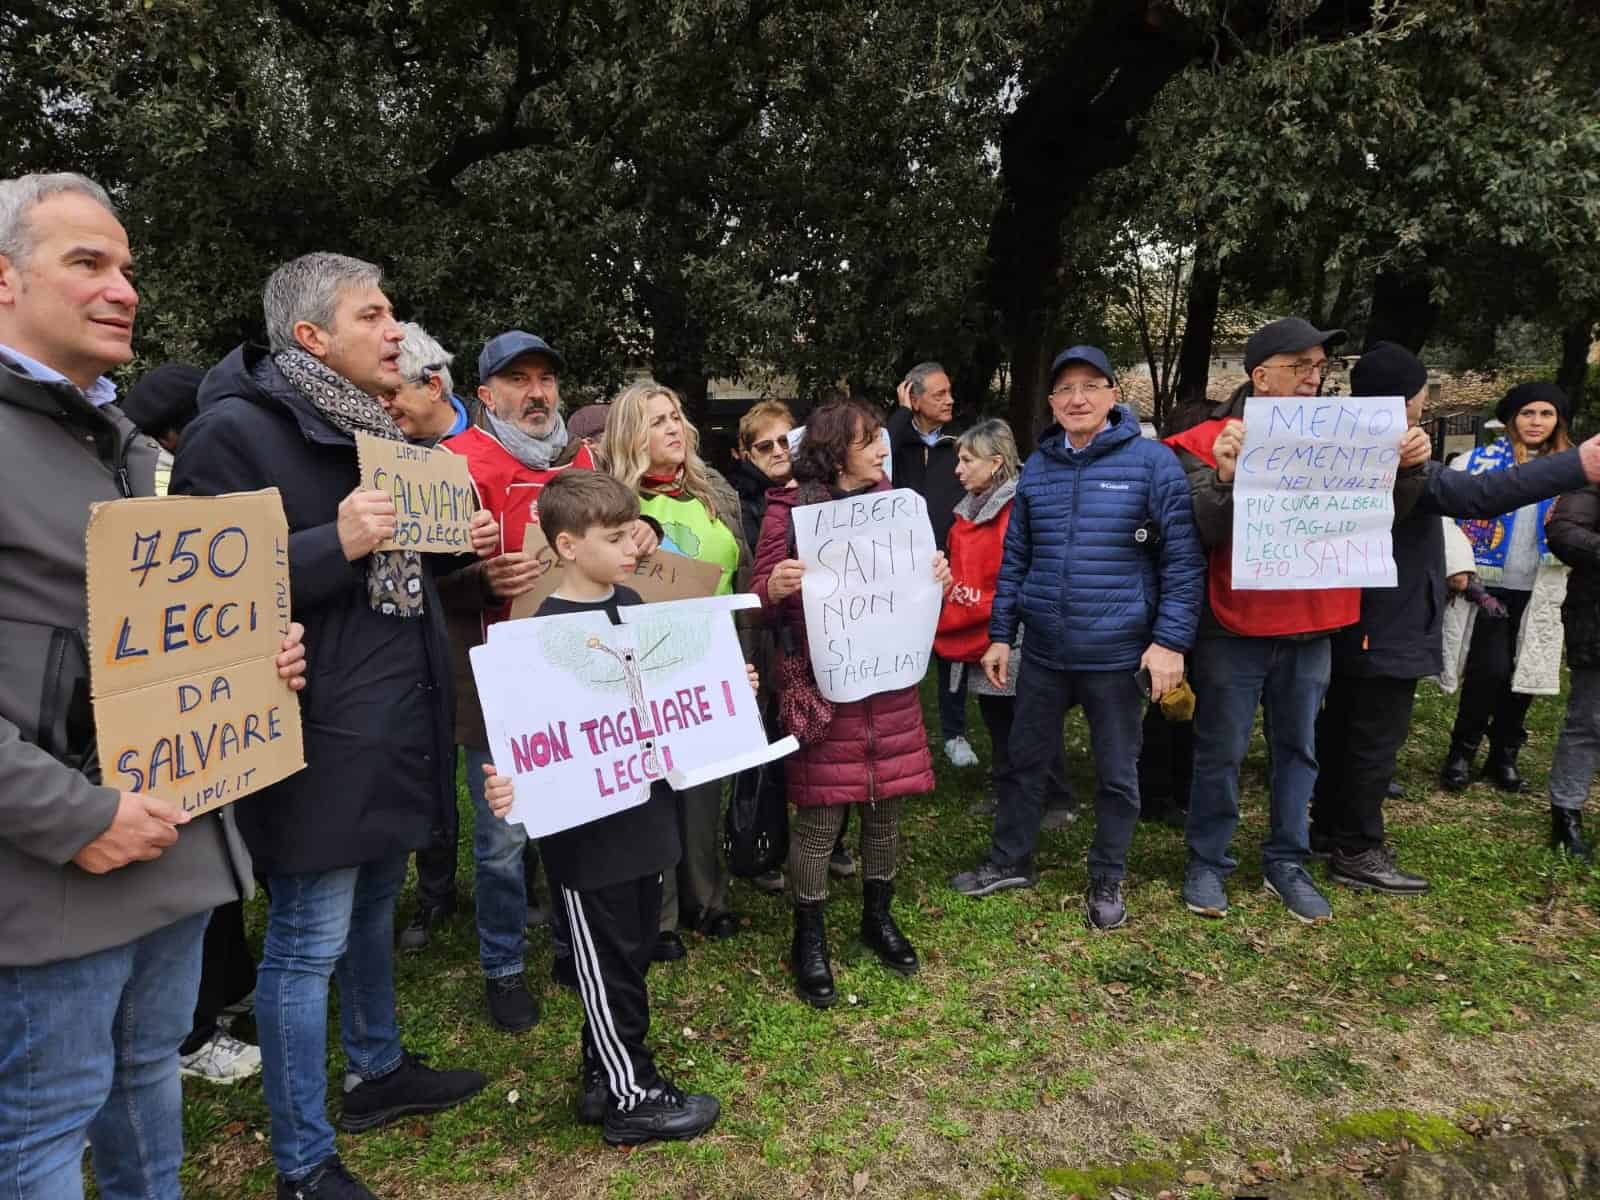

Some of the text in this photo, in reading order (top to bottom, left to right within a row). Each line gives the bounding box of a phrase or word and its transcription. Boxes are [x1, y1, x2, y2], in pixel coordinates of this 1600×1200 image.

[1269, 405, 1393, 438] MENO
[1243, 445, 1396, 474] CEMENTO
[1276, 476, 1313, 490] NEI
[815, 497, 919, 536] ALBERI
[1281, 495, 1320, 511] CURA
[427, 523, 467, 545] LECCI
[1246, 516, 1360, 539] NO TAGLIO
[130, 527, 248, 587] 750
[818, 529, 915, 599] SANI
[1242, 560, 1290, 580] 750
[1245, 538, 1388, 578] LECCI SANI
[115, 601, 257, 660] LECCI
[824, 591, 894, 634] NON
[828, 638, 851, 666] SI
[178, 676, 232, 713] DA
[510, 680, 736, 774] NON TAGLIARE I
[117, 707, 283, 793] SALVARE
[595, 745, 674, 797] LECCI
